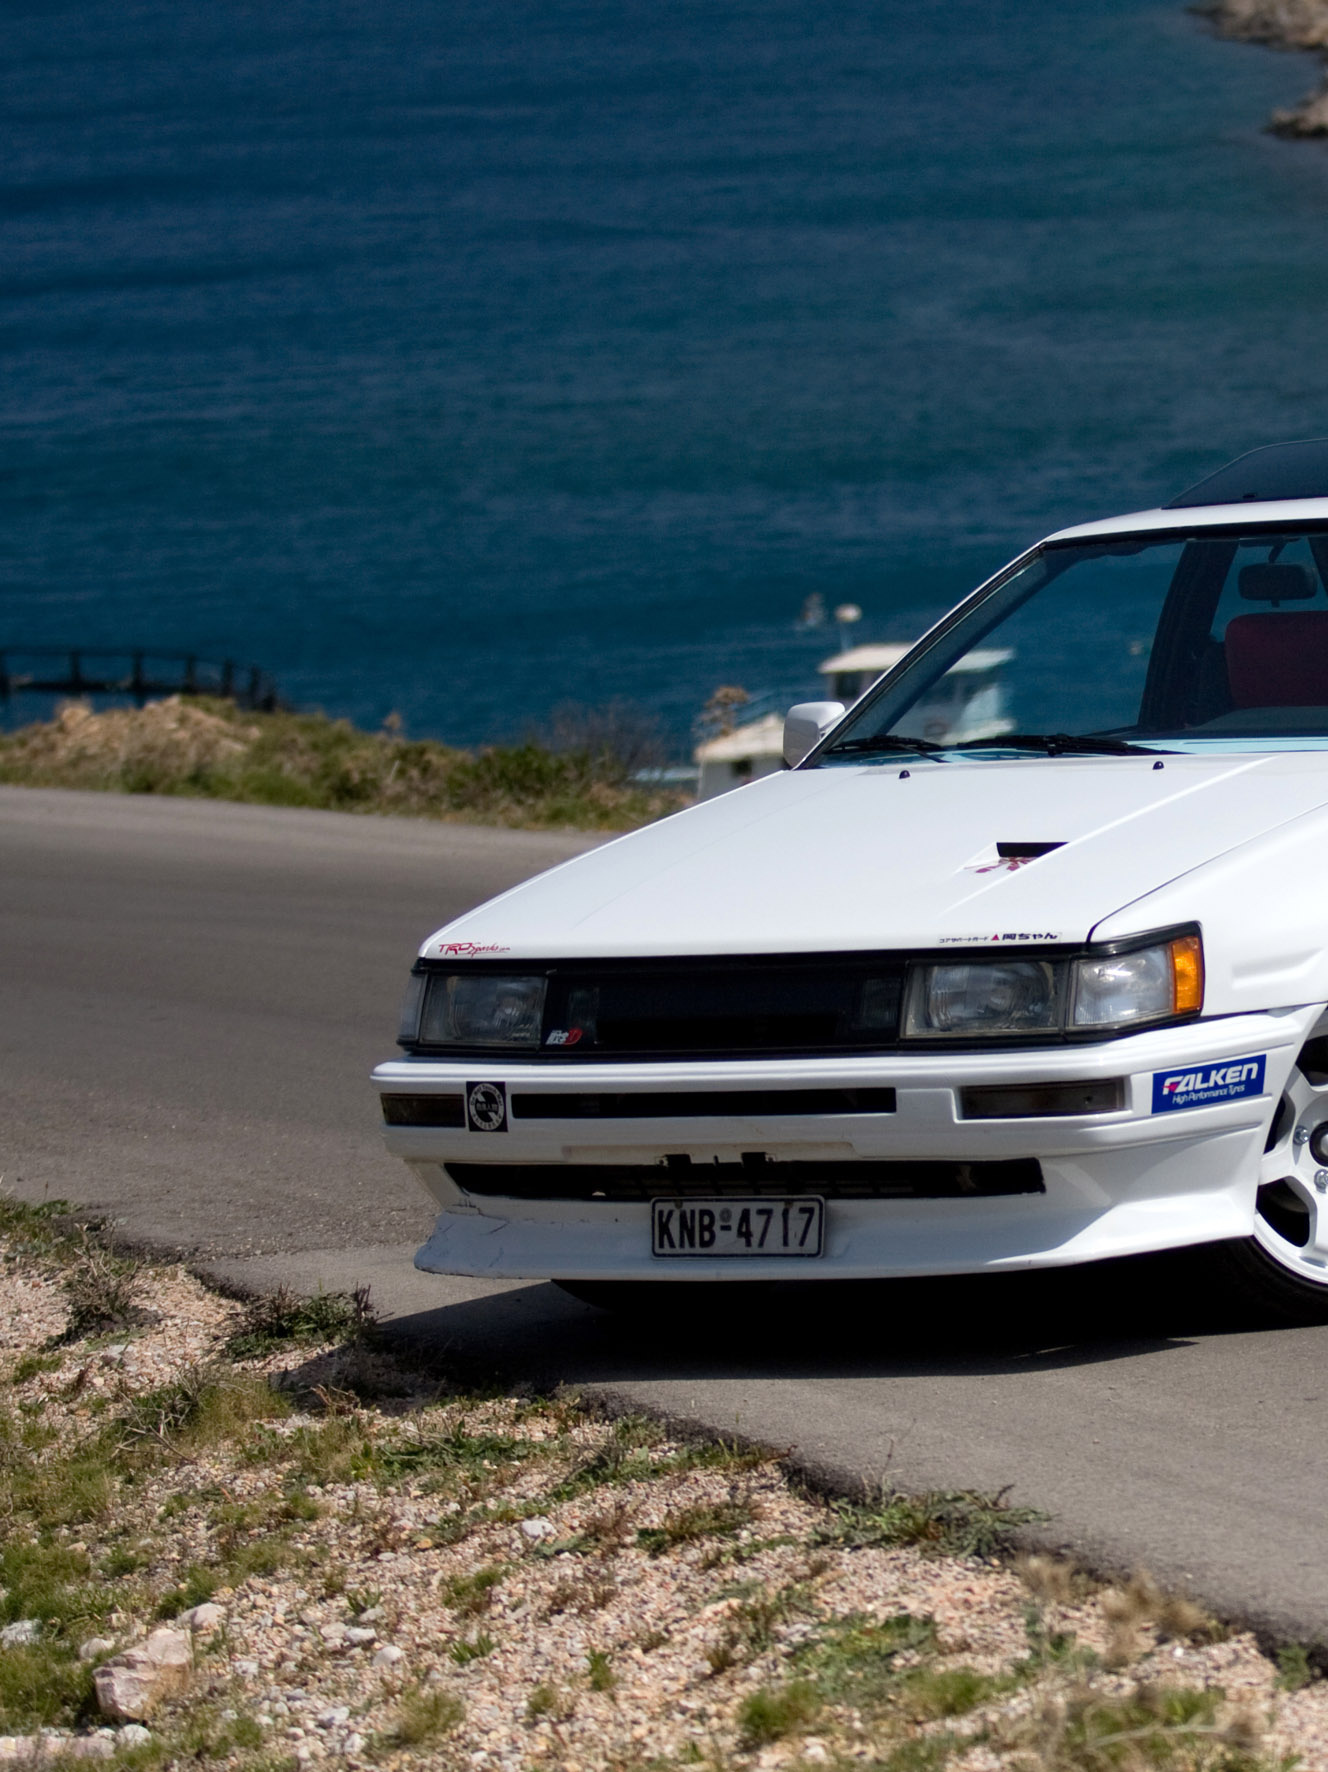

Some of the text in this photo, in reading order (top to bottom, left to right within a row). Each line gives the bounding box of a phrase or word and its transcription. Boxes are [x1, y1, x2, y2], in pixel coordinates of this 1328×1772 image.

[1162, 1063, 1259, 1096] FALKEN
[1172, 1093, 1189, 1105] High
[658, 1206, 815, 1249] KNB-4717
